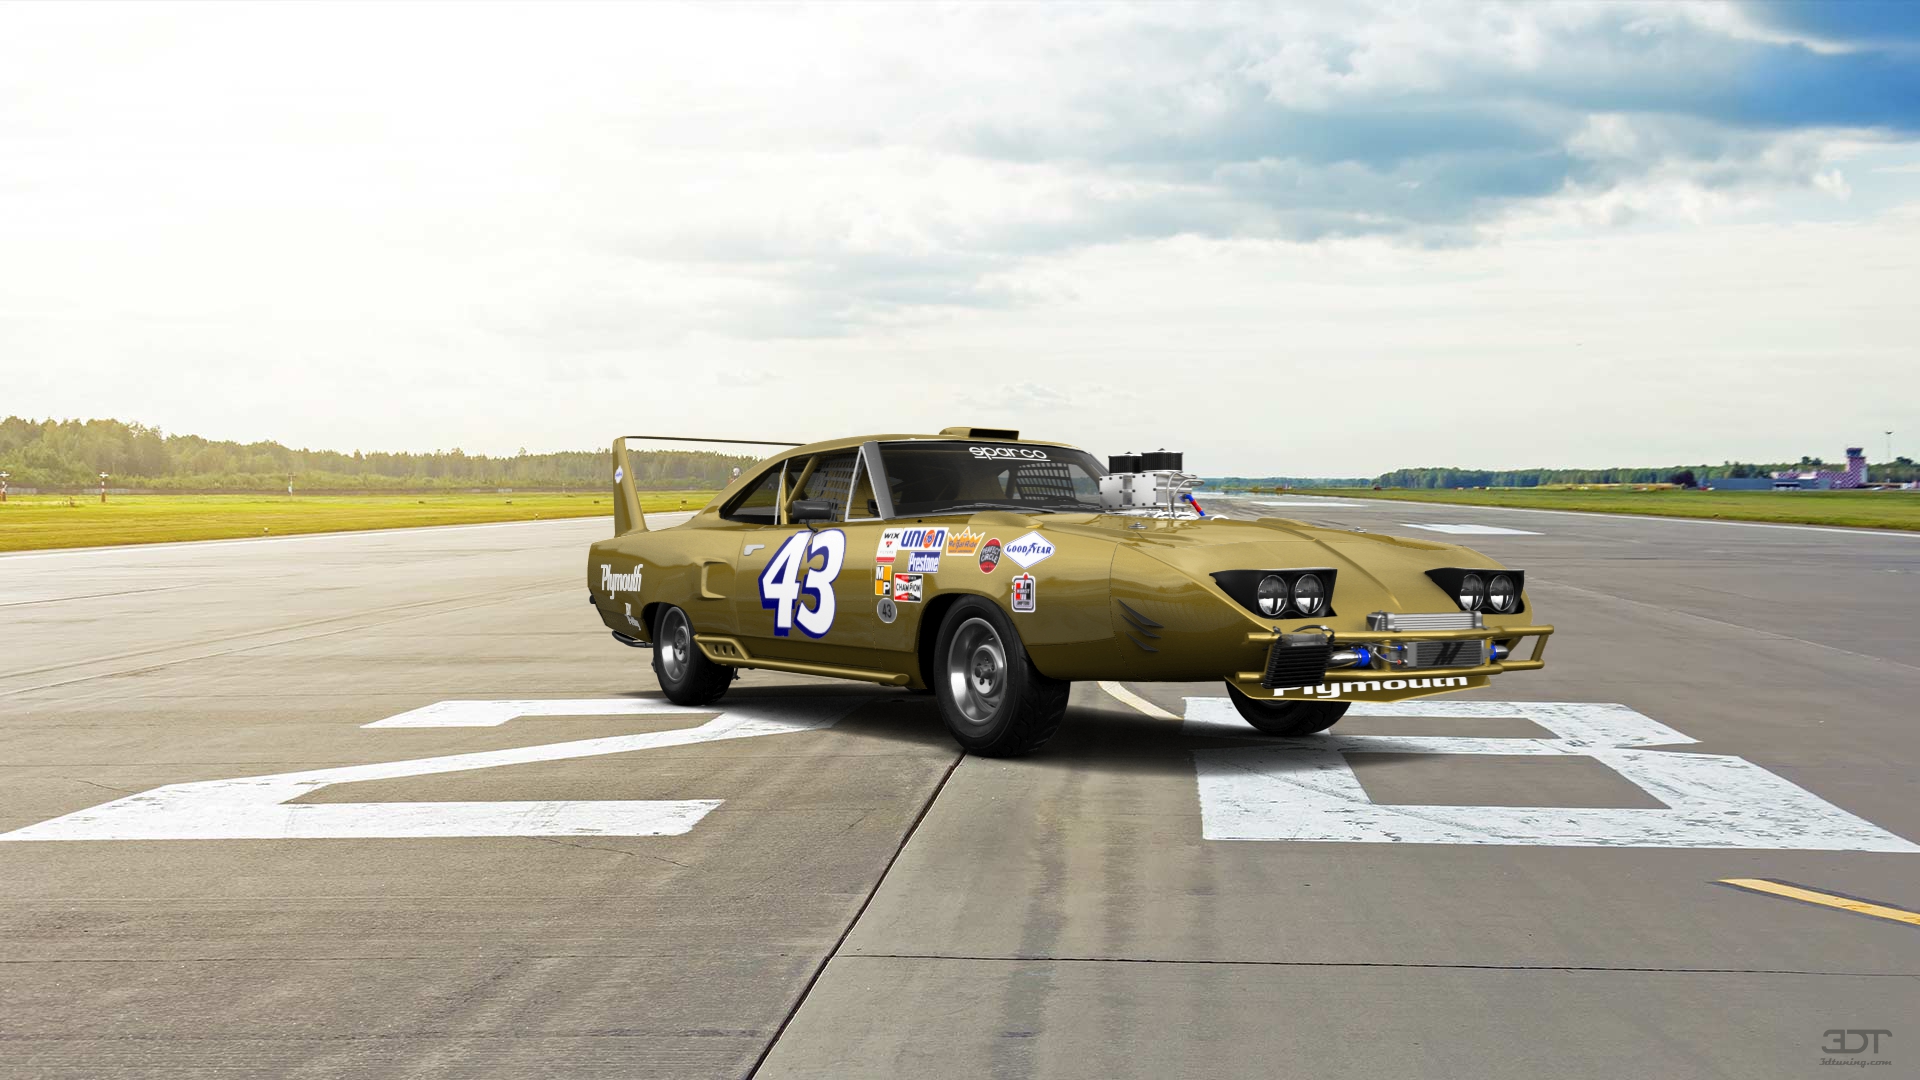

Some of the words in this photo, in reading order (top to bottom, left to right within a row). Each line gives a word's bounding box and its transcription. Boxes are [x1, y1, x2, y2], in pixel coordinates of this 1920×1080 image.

[968, 446, 1048, 460] sparco
[901, 529, 945, 548] UNION
[909, 552, 940, 571] Prestone
[600, 563, 643, 599] Plymouth
[758, 528, 847, 639] 43
[896, 582, 921, 592] CHAMPION
[882, 603, 892, 618] 43
